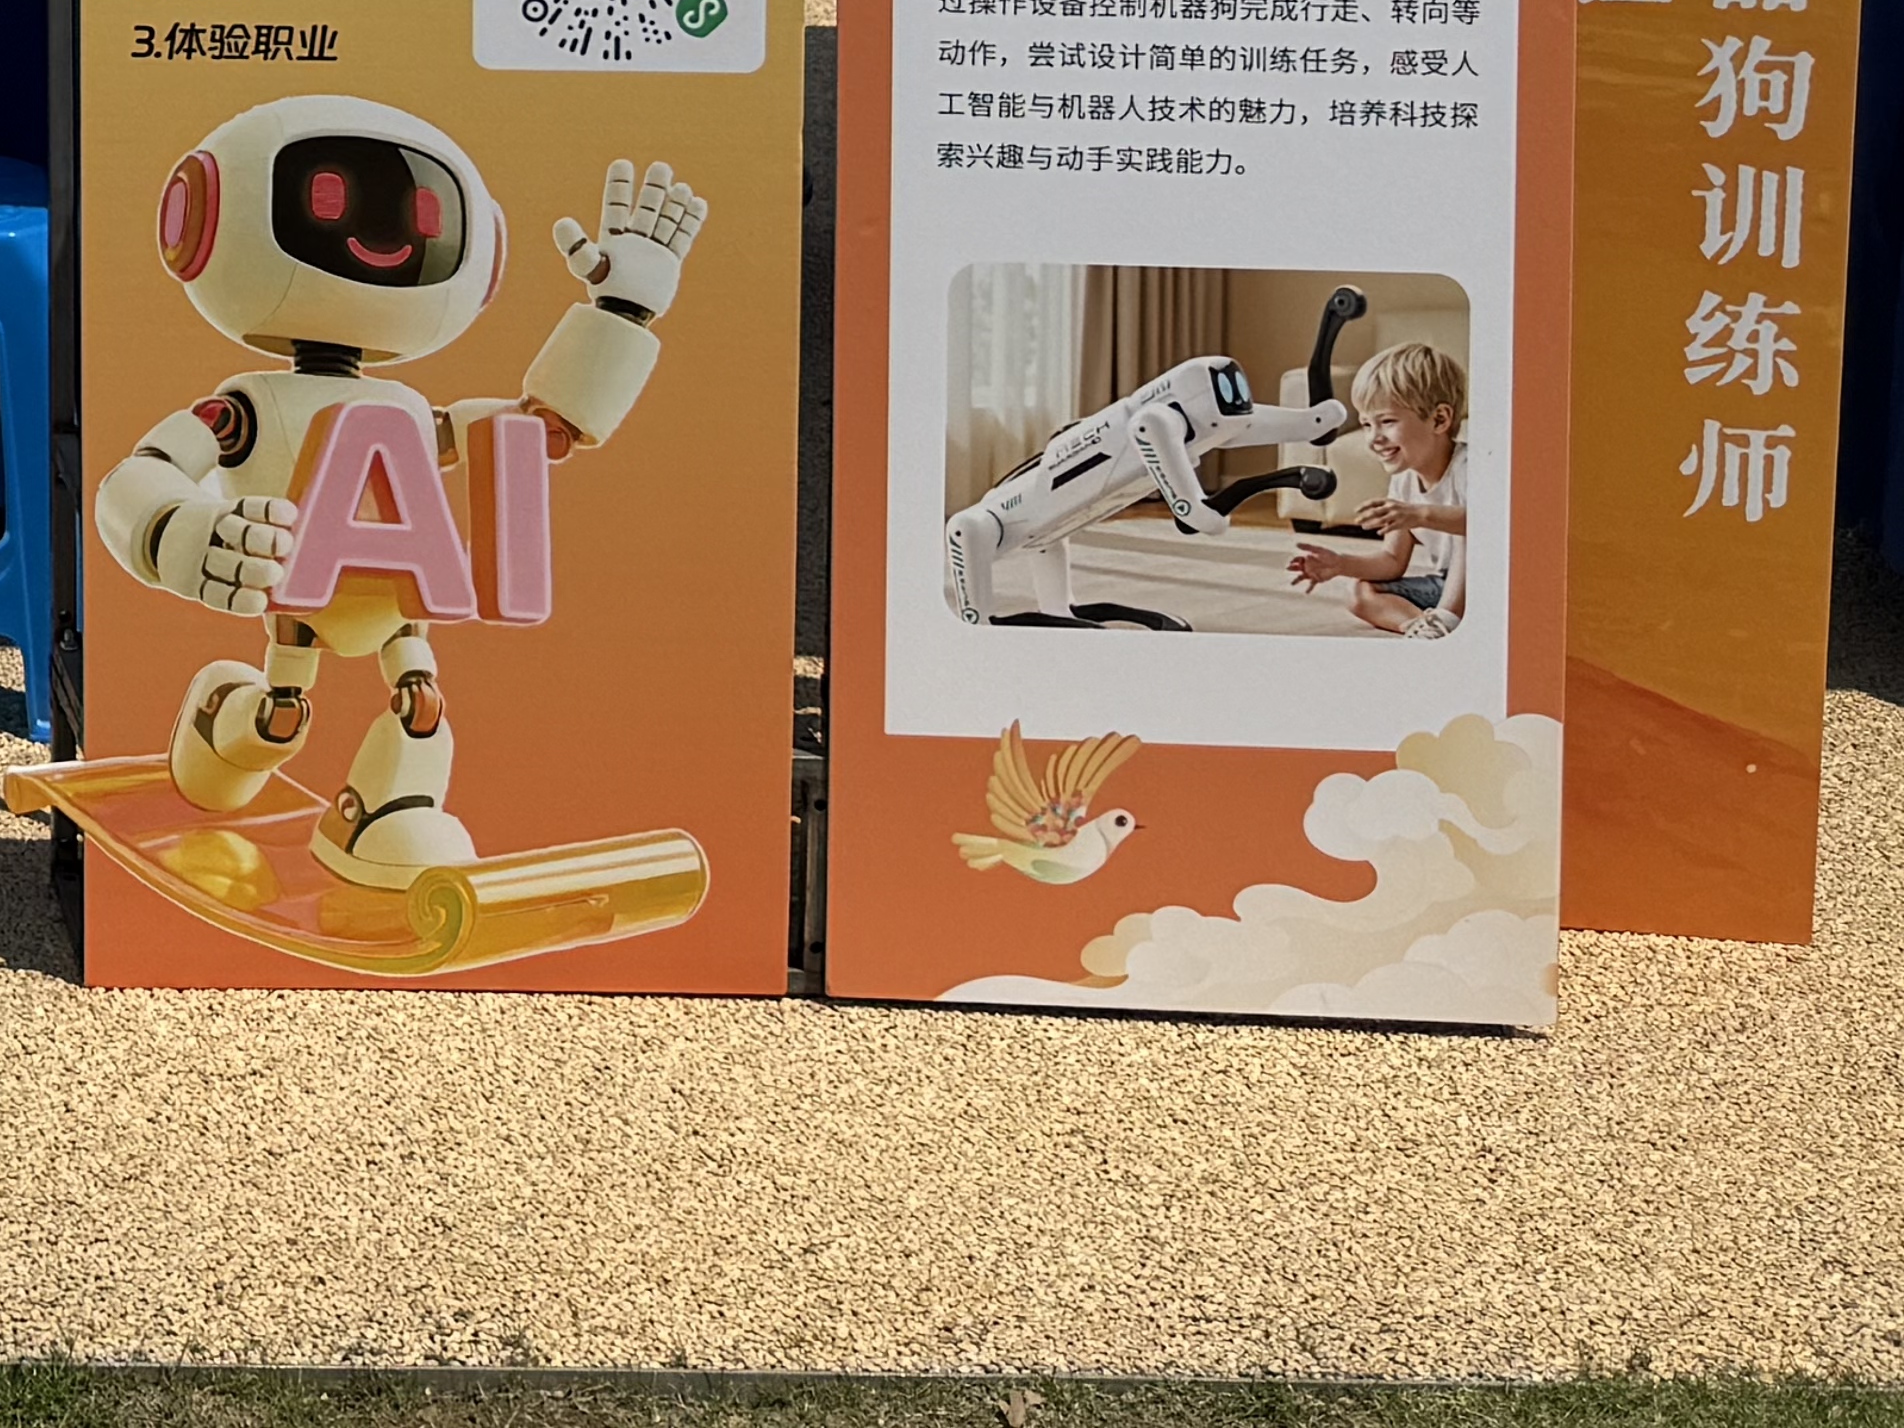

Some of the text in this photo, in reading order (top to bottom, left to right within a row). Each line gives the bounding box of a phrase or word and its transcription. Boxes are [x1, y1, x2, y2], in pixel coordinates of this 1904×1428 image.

[130, 22, 339, 62] 3.体验职业
[937, 39, 1479, 79] 动作，尝试设计简单的训练任务，感受人
[937, 91, 1479, 130] 工智能与机器人技术的魅力，培养科技探
[936, 142, 1248, 177] 索兴趣与动手实践能力。
[267, 397, 554, 627] AI
